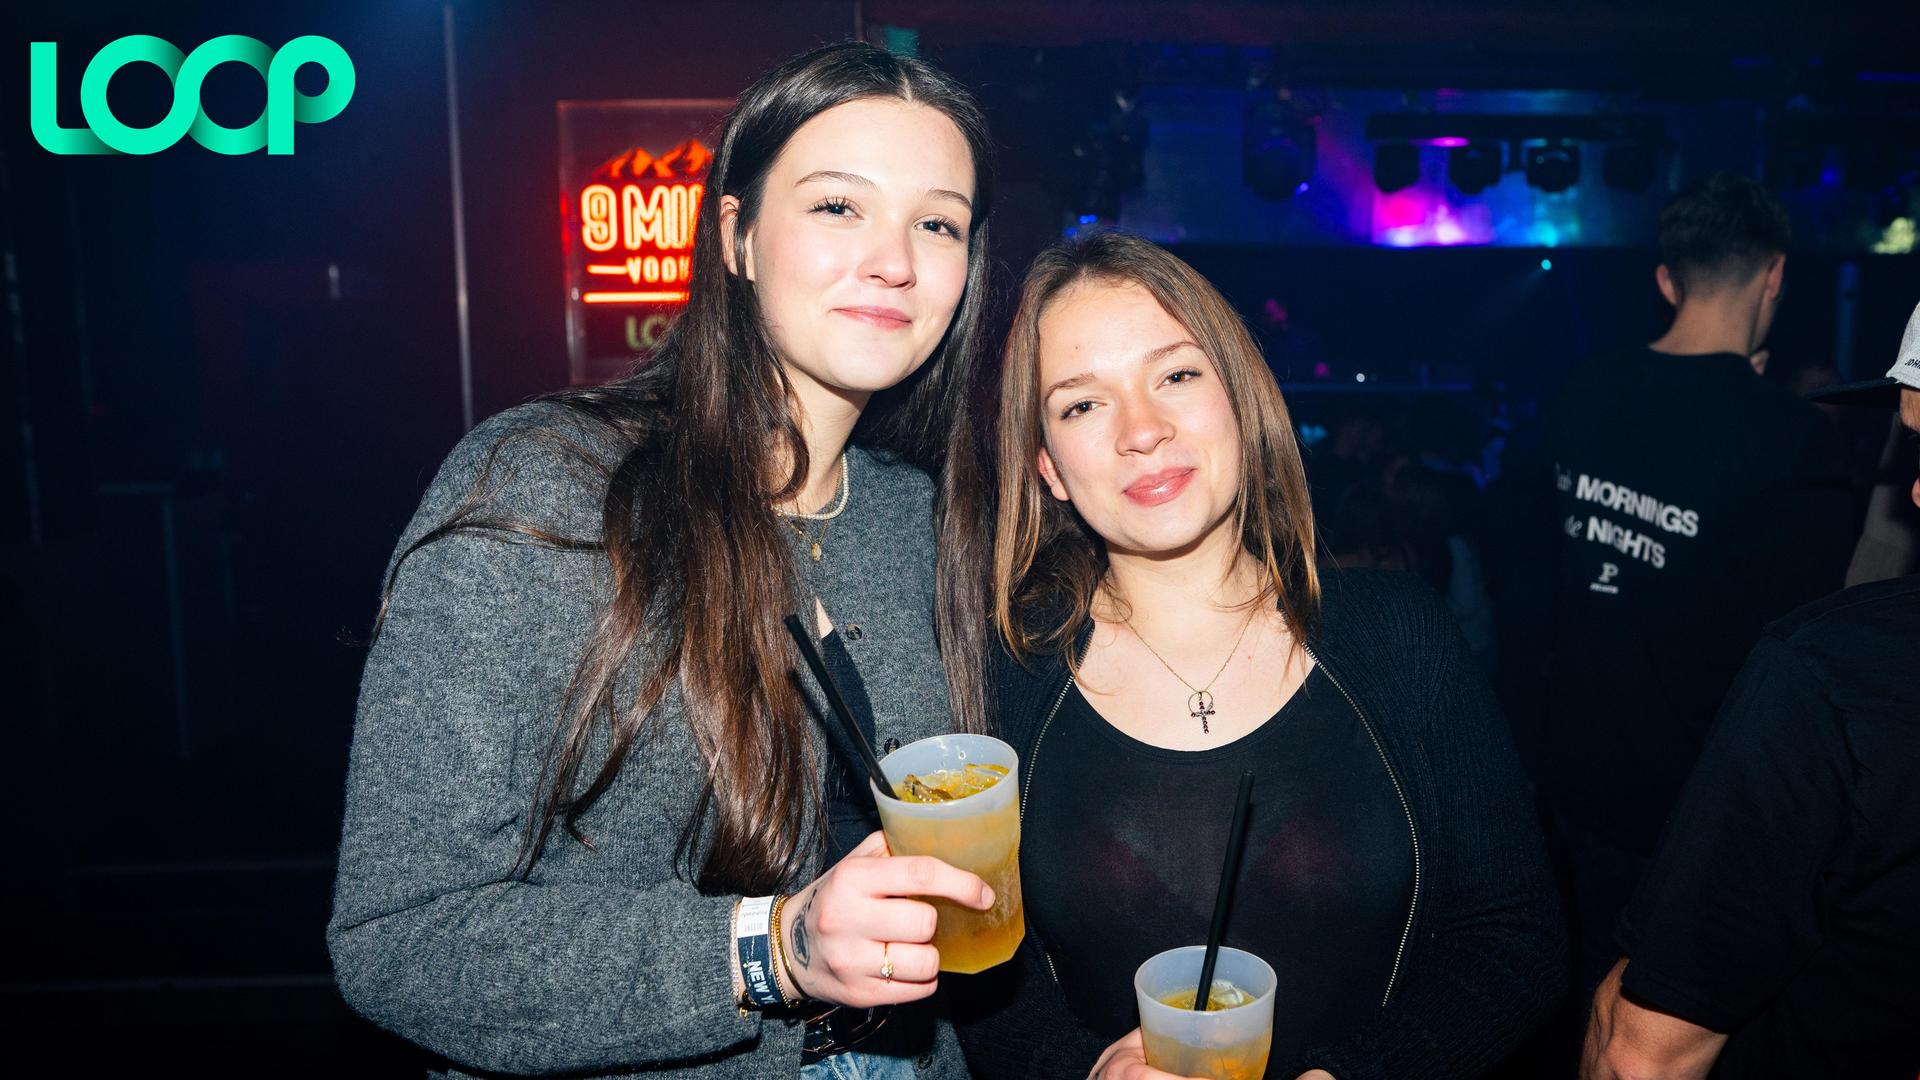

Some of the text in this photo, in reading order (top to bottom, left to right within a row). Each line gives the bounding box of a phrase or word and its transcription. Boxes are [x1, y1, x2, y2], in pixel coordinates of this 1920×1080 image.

[580, 183, 618, 252] 9
[1576, 473, 1700, 538] MORNINGS
[1586, 515, 1666, 569] NIGHTS
[749, 960, 770, 993] NEW
